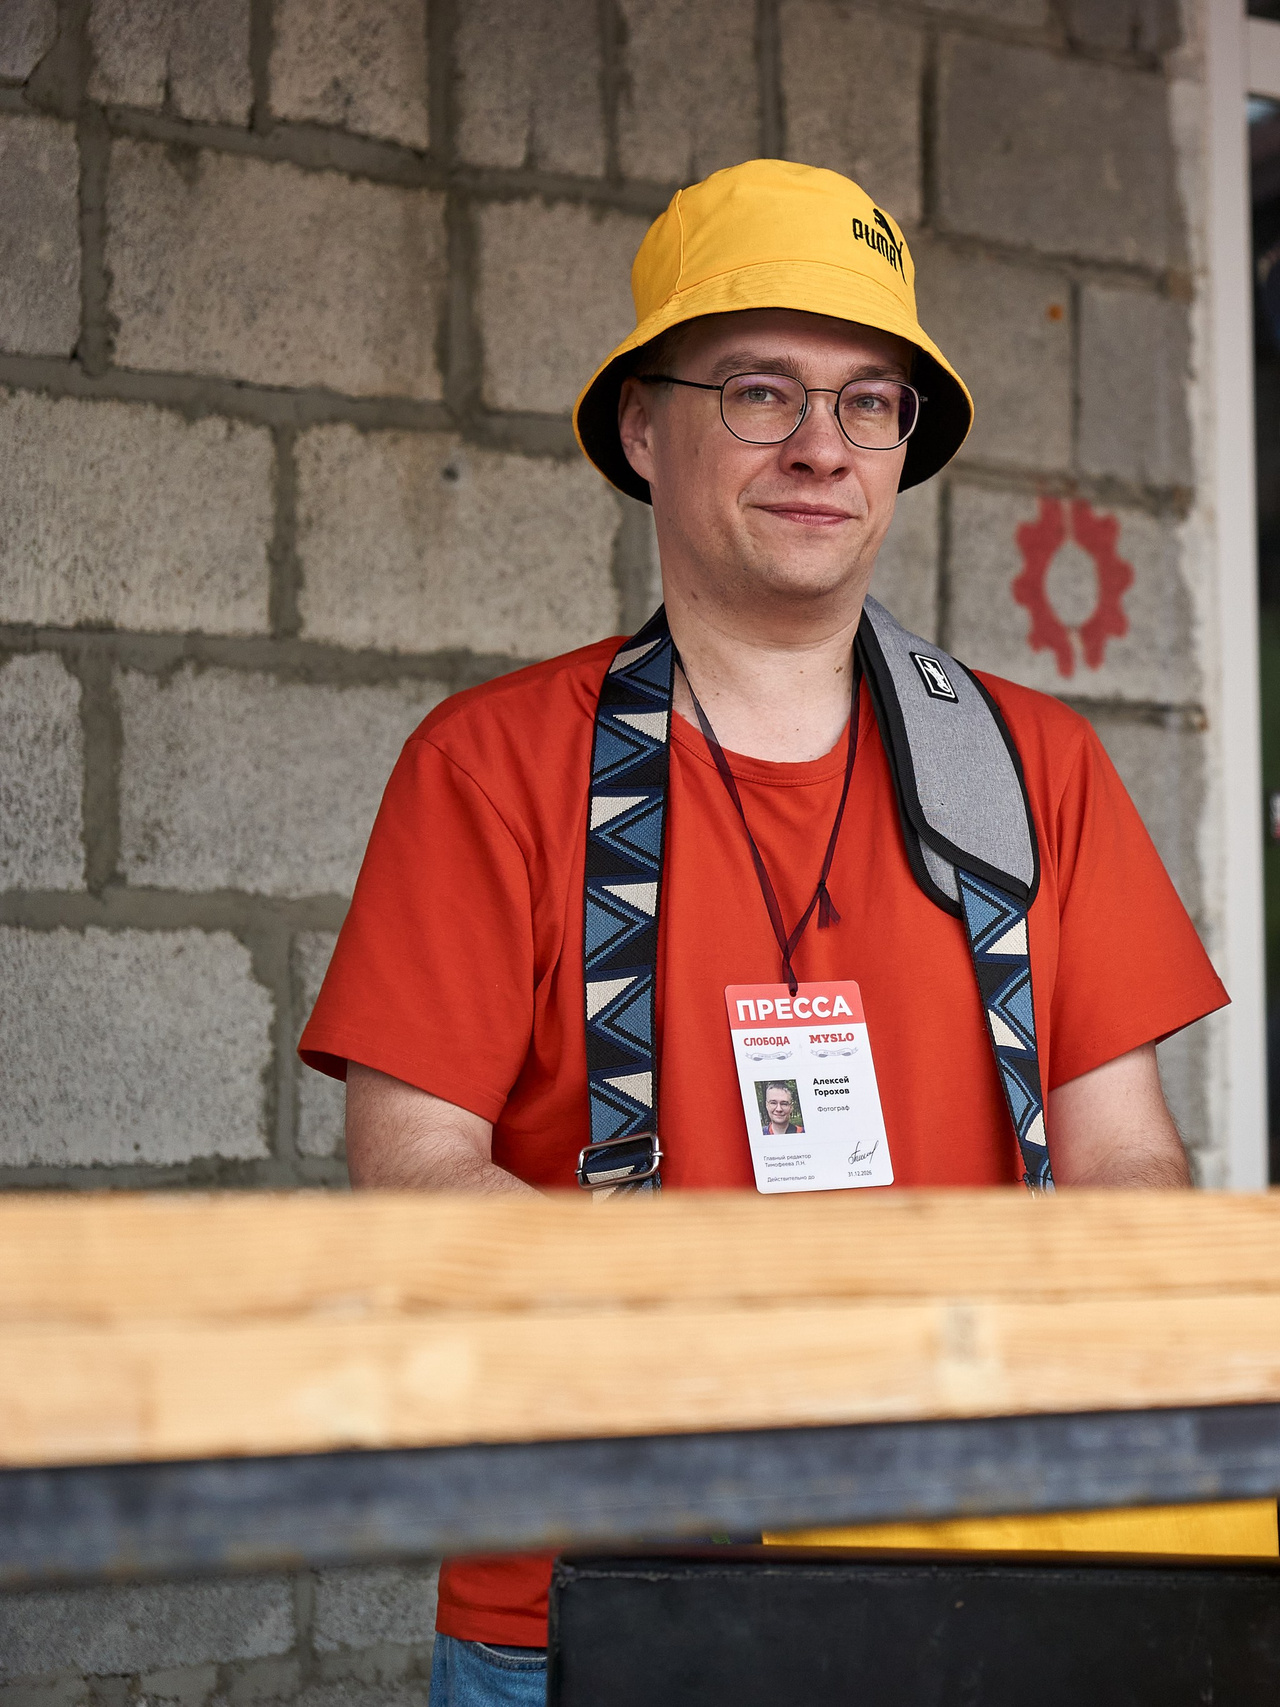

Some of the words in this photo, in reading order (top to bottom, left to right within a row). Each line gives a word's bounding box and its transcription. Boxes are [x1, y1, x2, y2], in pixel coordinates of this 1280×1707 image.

[852, 218, 898, 272] PUMA
[736, 995, 853, 1022] ПРЕССА
[743, 1036, 790, 1047] СЛОБОДА
[809, 1032, 855, 1044] MYSLO
[813, 1076, 850, 1086] Алексей
[814, 1088, 850, 1097] Горохов
[817, 1105, 850, 1113] Фотограф
[767, 1175, 808, 1183] Действительно
